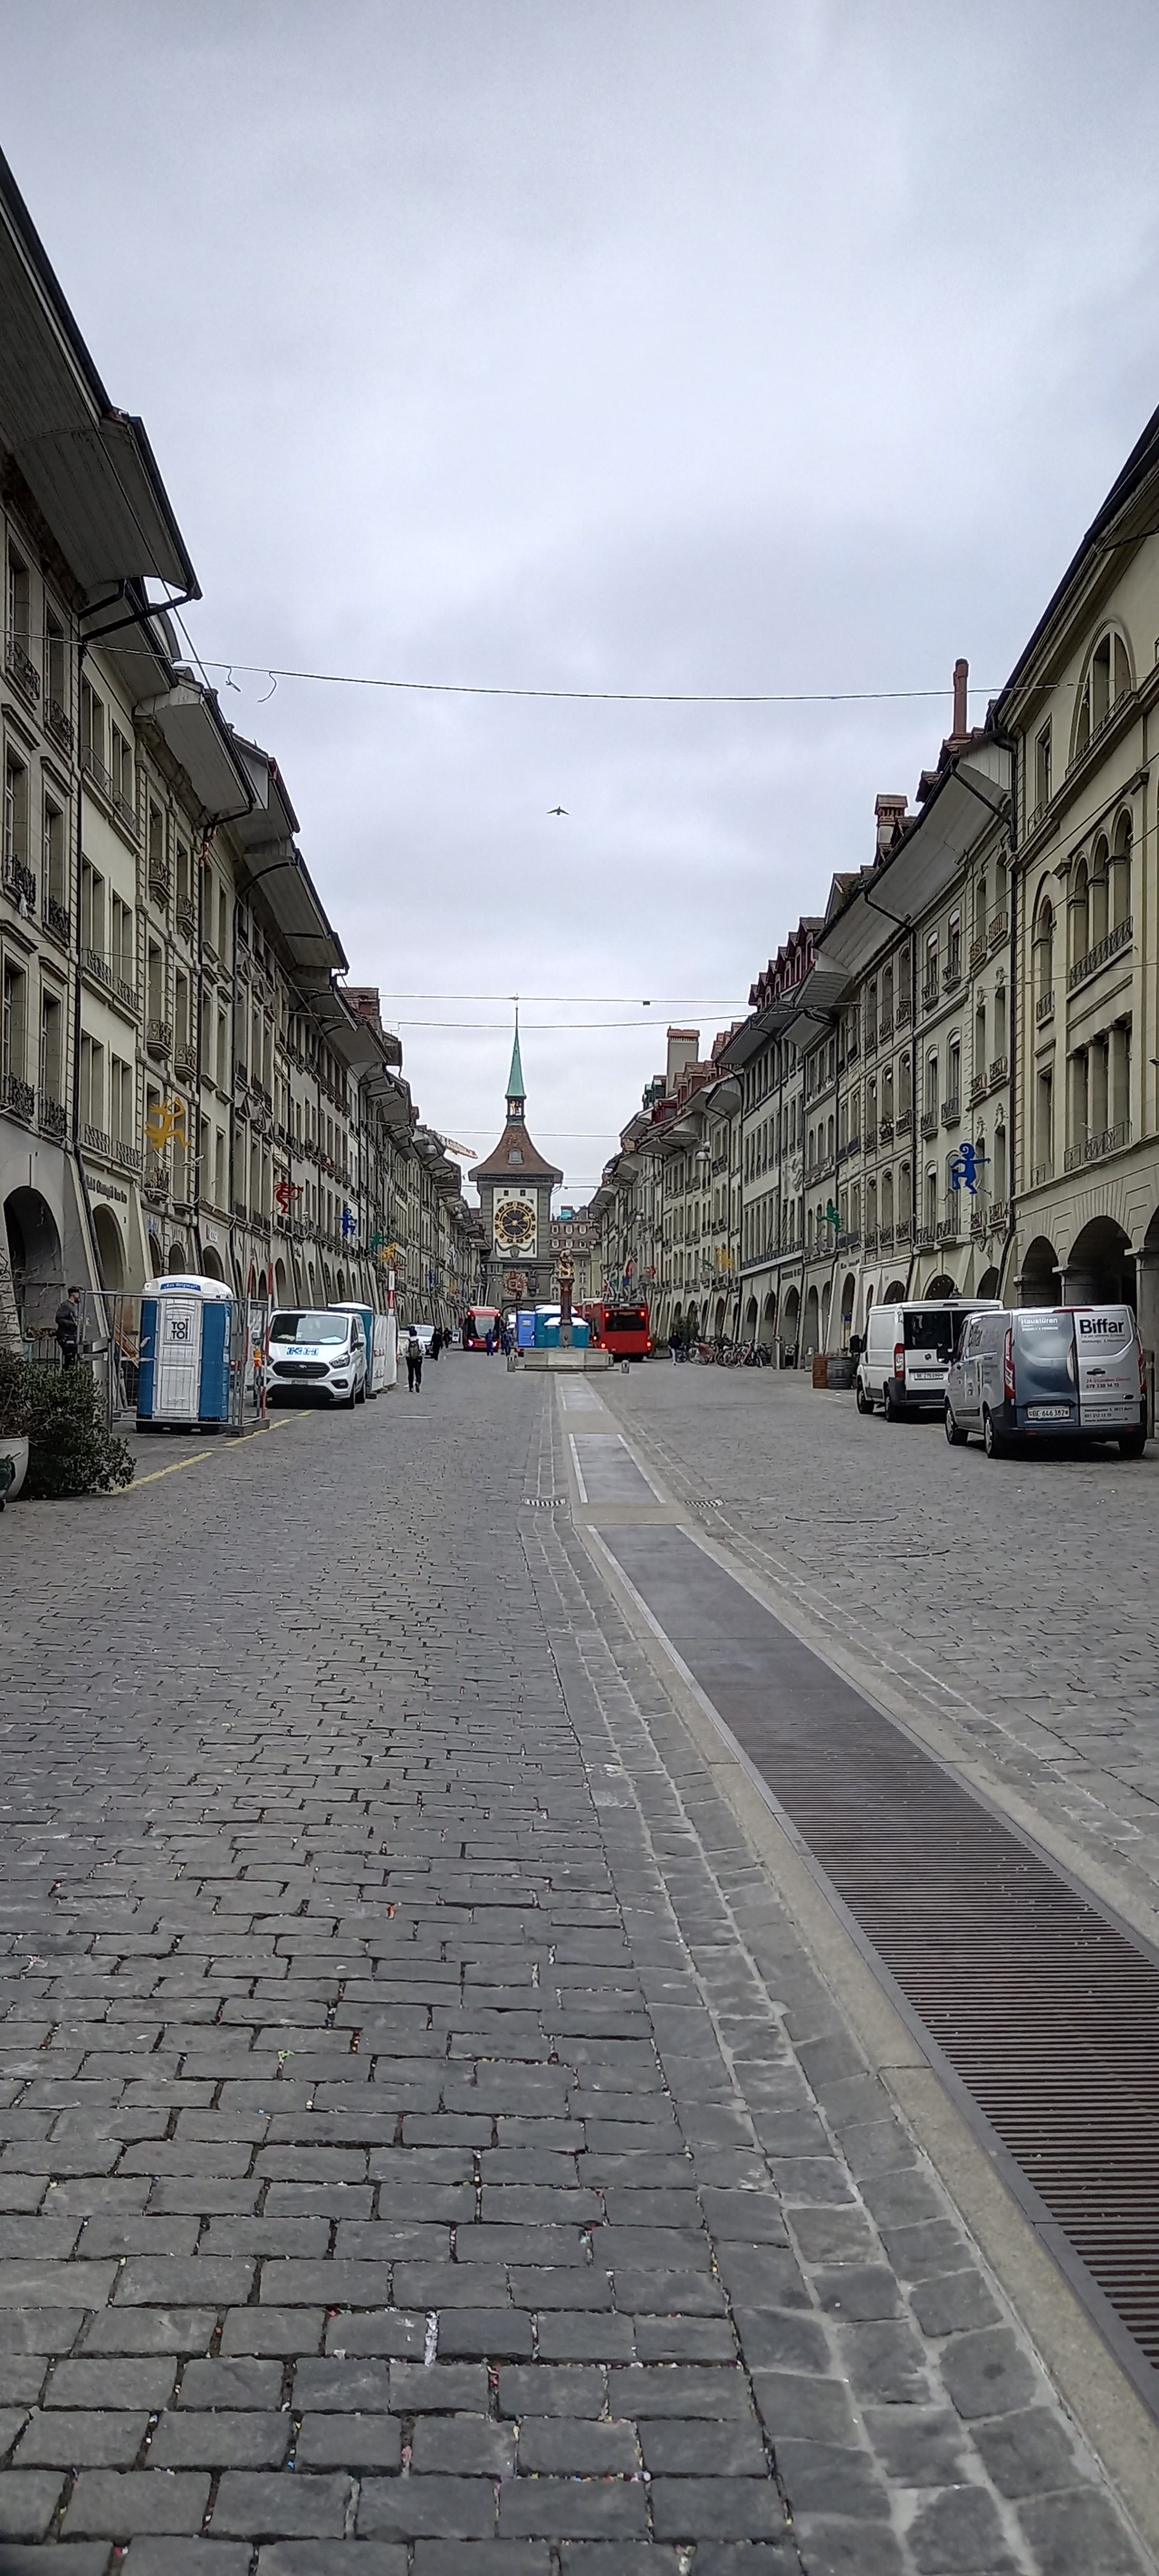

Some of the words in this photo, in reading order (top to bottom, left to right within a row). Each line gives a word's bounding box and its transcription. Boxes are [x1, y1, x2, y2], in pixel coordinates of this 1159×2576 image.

[171, 1319, 189, 1331] TOI
[1079, 1318, 1125, 1334] Biffar
[171, 1331, 188, 1340] TOI
